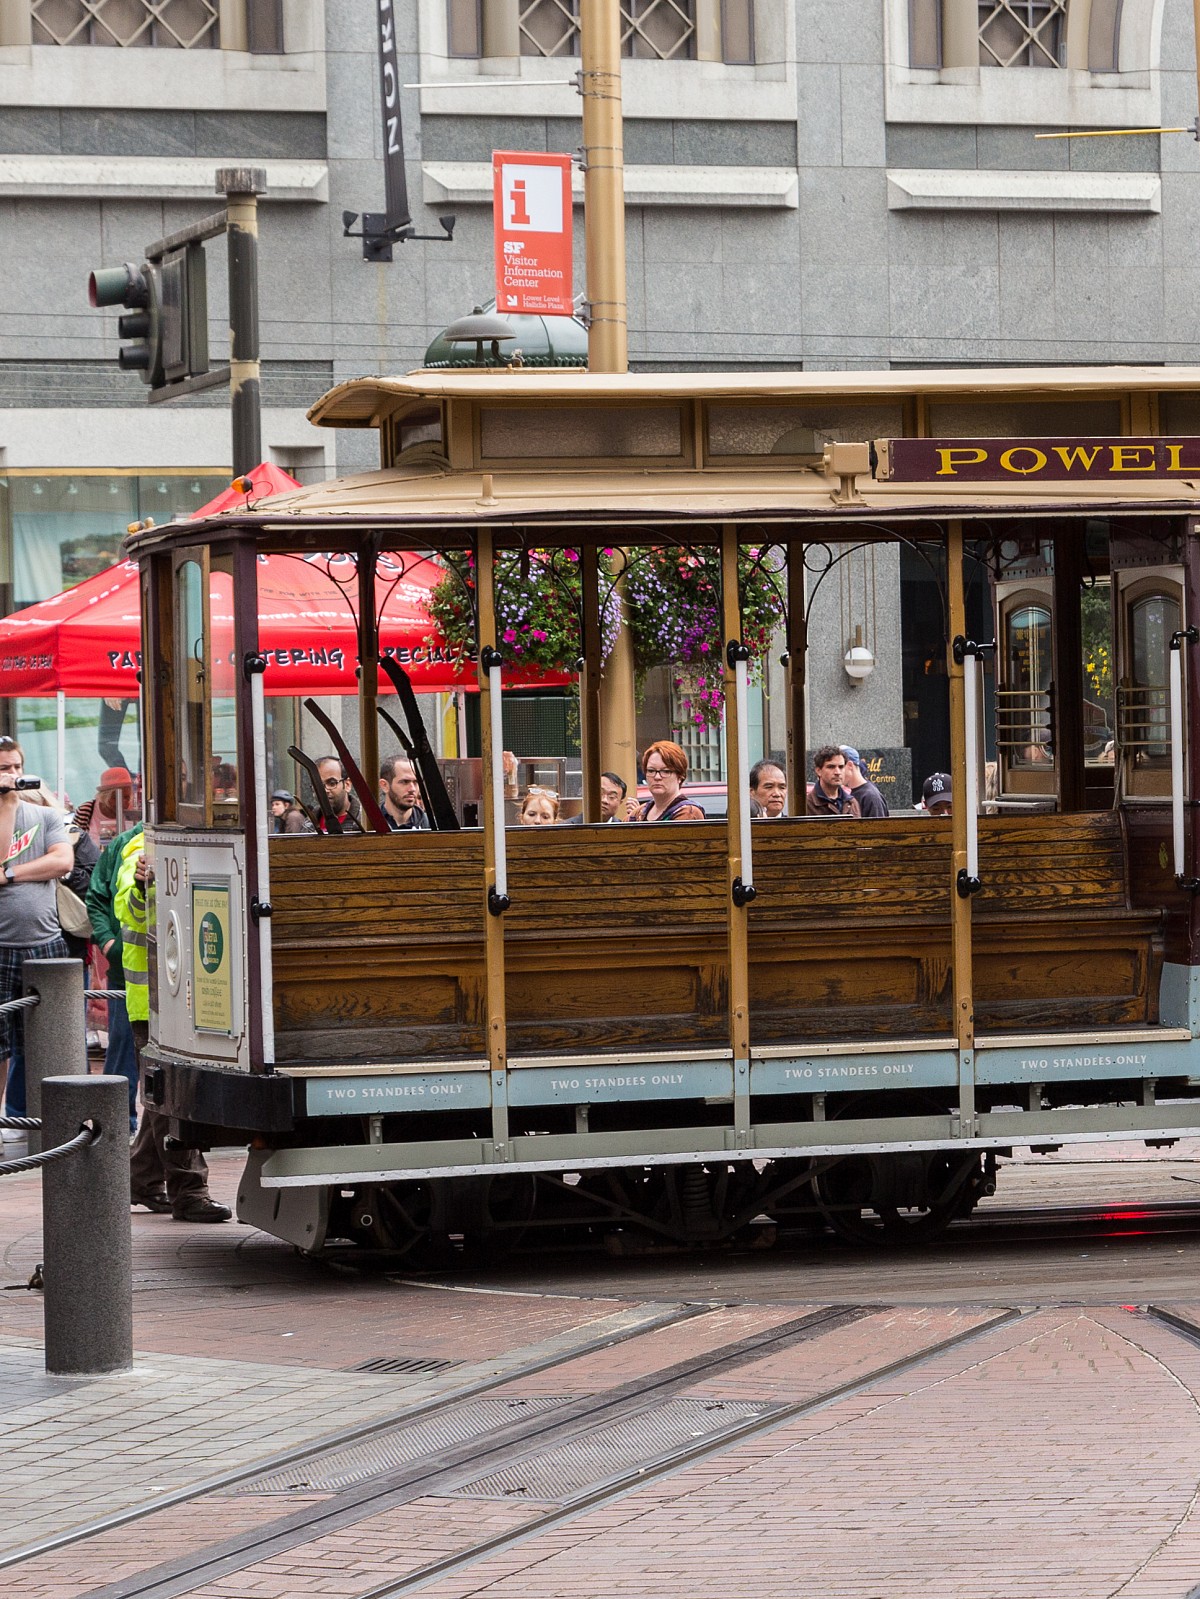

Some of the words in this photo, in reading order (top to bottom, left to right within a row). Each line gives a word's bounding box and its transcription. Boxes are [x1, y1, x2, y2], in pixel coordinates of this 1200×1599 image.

[380, 0, 399, 154] NOR
[503, 241, 525, 255] SF
[504, 255, 538, 266] Visitor
[503, 265, 563, 279] Information
[503, 276, 539, 288] Center
[523, 294, 542, 302] Lower
[228, 647, 344, 670] CTERING
[870, 774, 896, 783] Centre
[164, 857, 179, 897] 19
[1020, 1059, 1048, 1070] TWO
[1052, 1057, 1112, 1069] STANDEES
[1116, 1054, 1148, 1065] ONLY
[785, 1068, 813, 1079] TWO
[817, 1065, 878, 1077] STANDEES
[882, 1064, 915, 1075] ONLY
[551, 1079, 580, 1090] TWO
[585, 1077, 646, 1088] STANDEES
[651, 1074, 684, 1085] ONLY
[327, 1088, 356, 1099] TWO
[361, 1086, 425, 1098] STANDEES
[430, 1084, 464, 1095] ONLY
